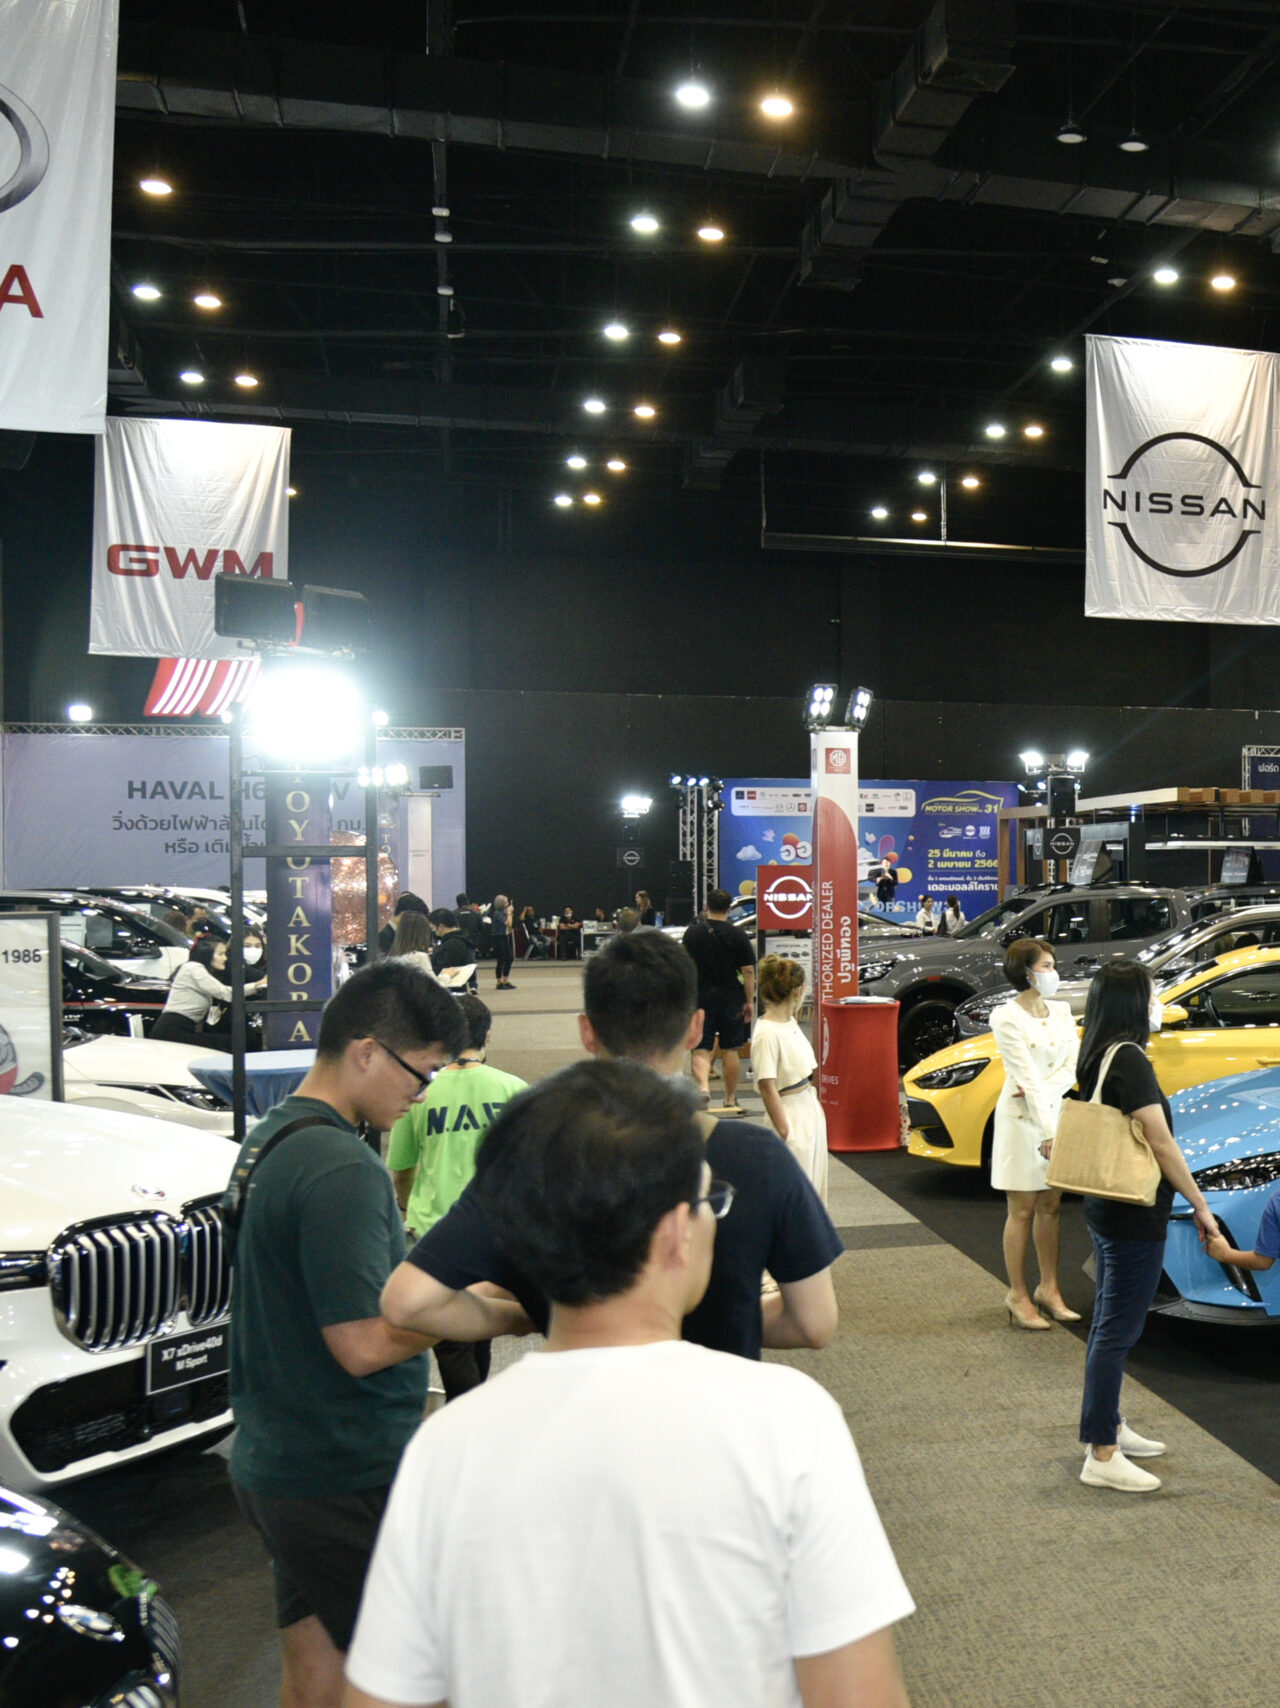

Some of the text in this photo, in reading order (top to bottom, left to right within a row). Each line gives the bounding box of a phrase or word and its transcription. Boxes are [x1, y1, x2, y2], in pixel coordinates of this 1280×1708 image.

[1103, 489, 1266, 521] NISSAN
[107, 544, 274, 581] GWM
[127, 780, 224, 800] HAVAL
[984, 803, 998, 814] 31
[165, 838, 199, 853] หรือ
[928, 859, 935, 868] 2
[822, 880, 833, 1000] THORIZED DEALER
[2, 948, 42, 963] 1986
